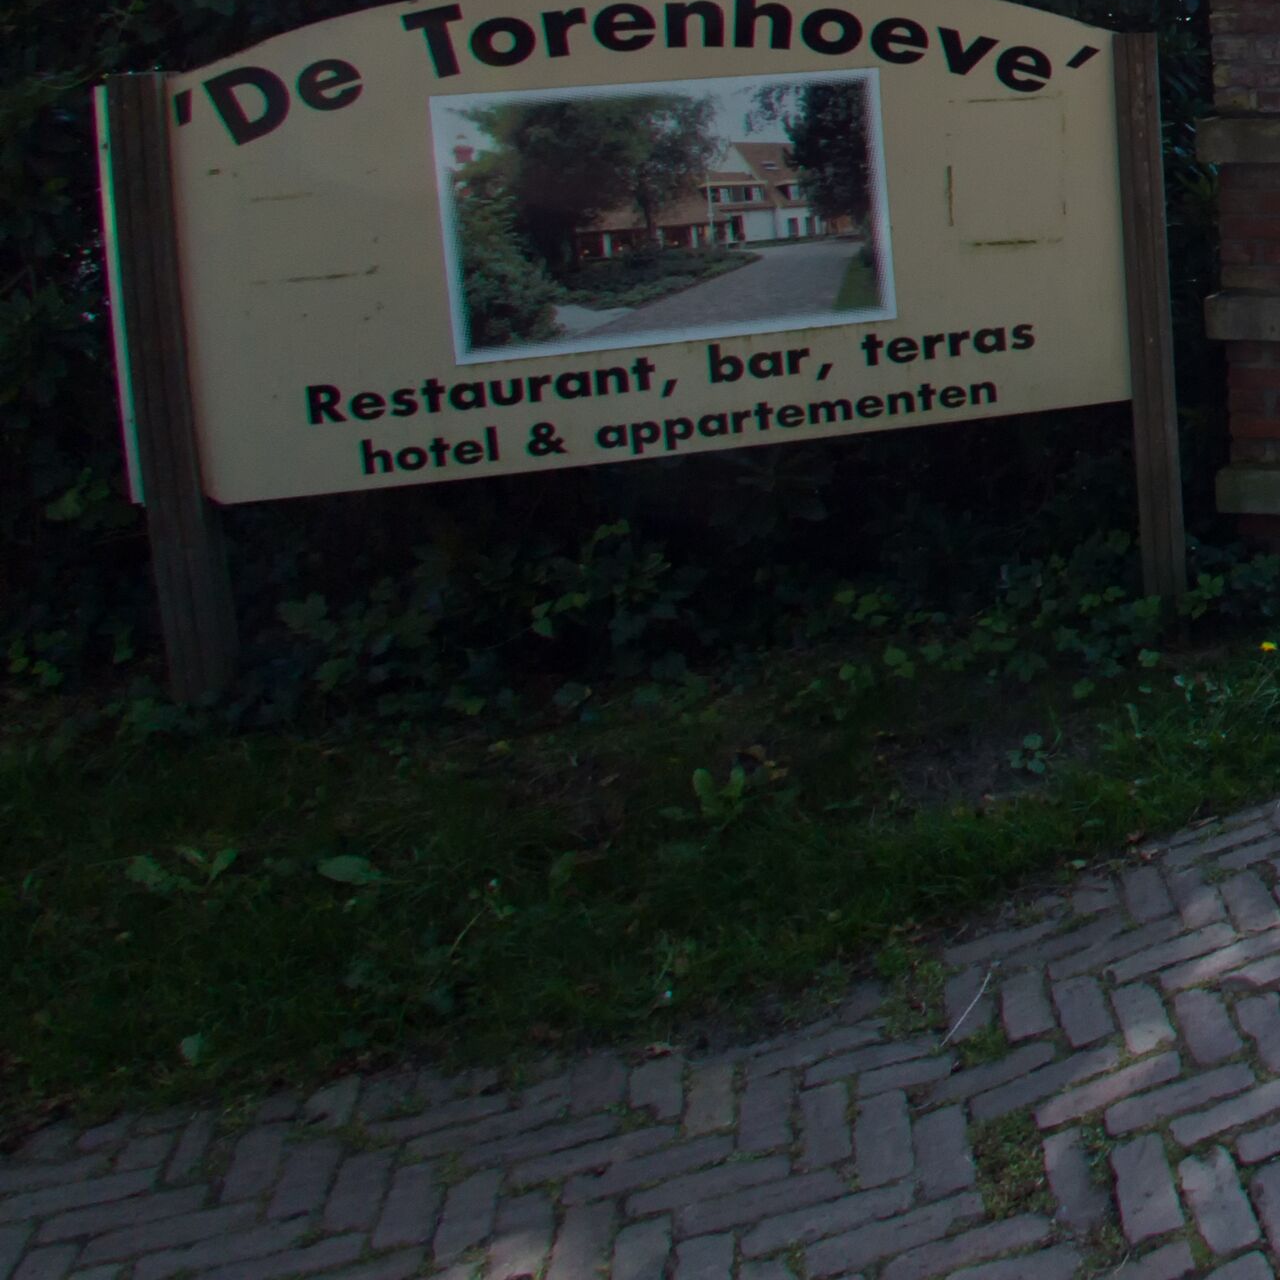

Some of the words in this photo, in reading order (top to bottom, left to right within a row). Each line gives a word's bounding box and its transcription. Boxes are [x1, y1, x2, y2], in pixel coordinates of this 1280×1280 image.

[304, 357, 678, 426] Restaurant,
[707, 343, 835, 384] bar,
[860, 322, 1036, 367] terras
[360, 425, 500, 476] hotel
[526, 421, 568, 457] &
[595, 376, 998, 454] appartementen
